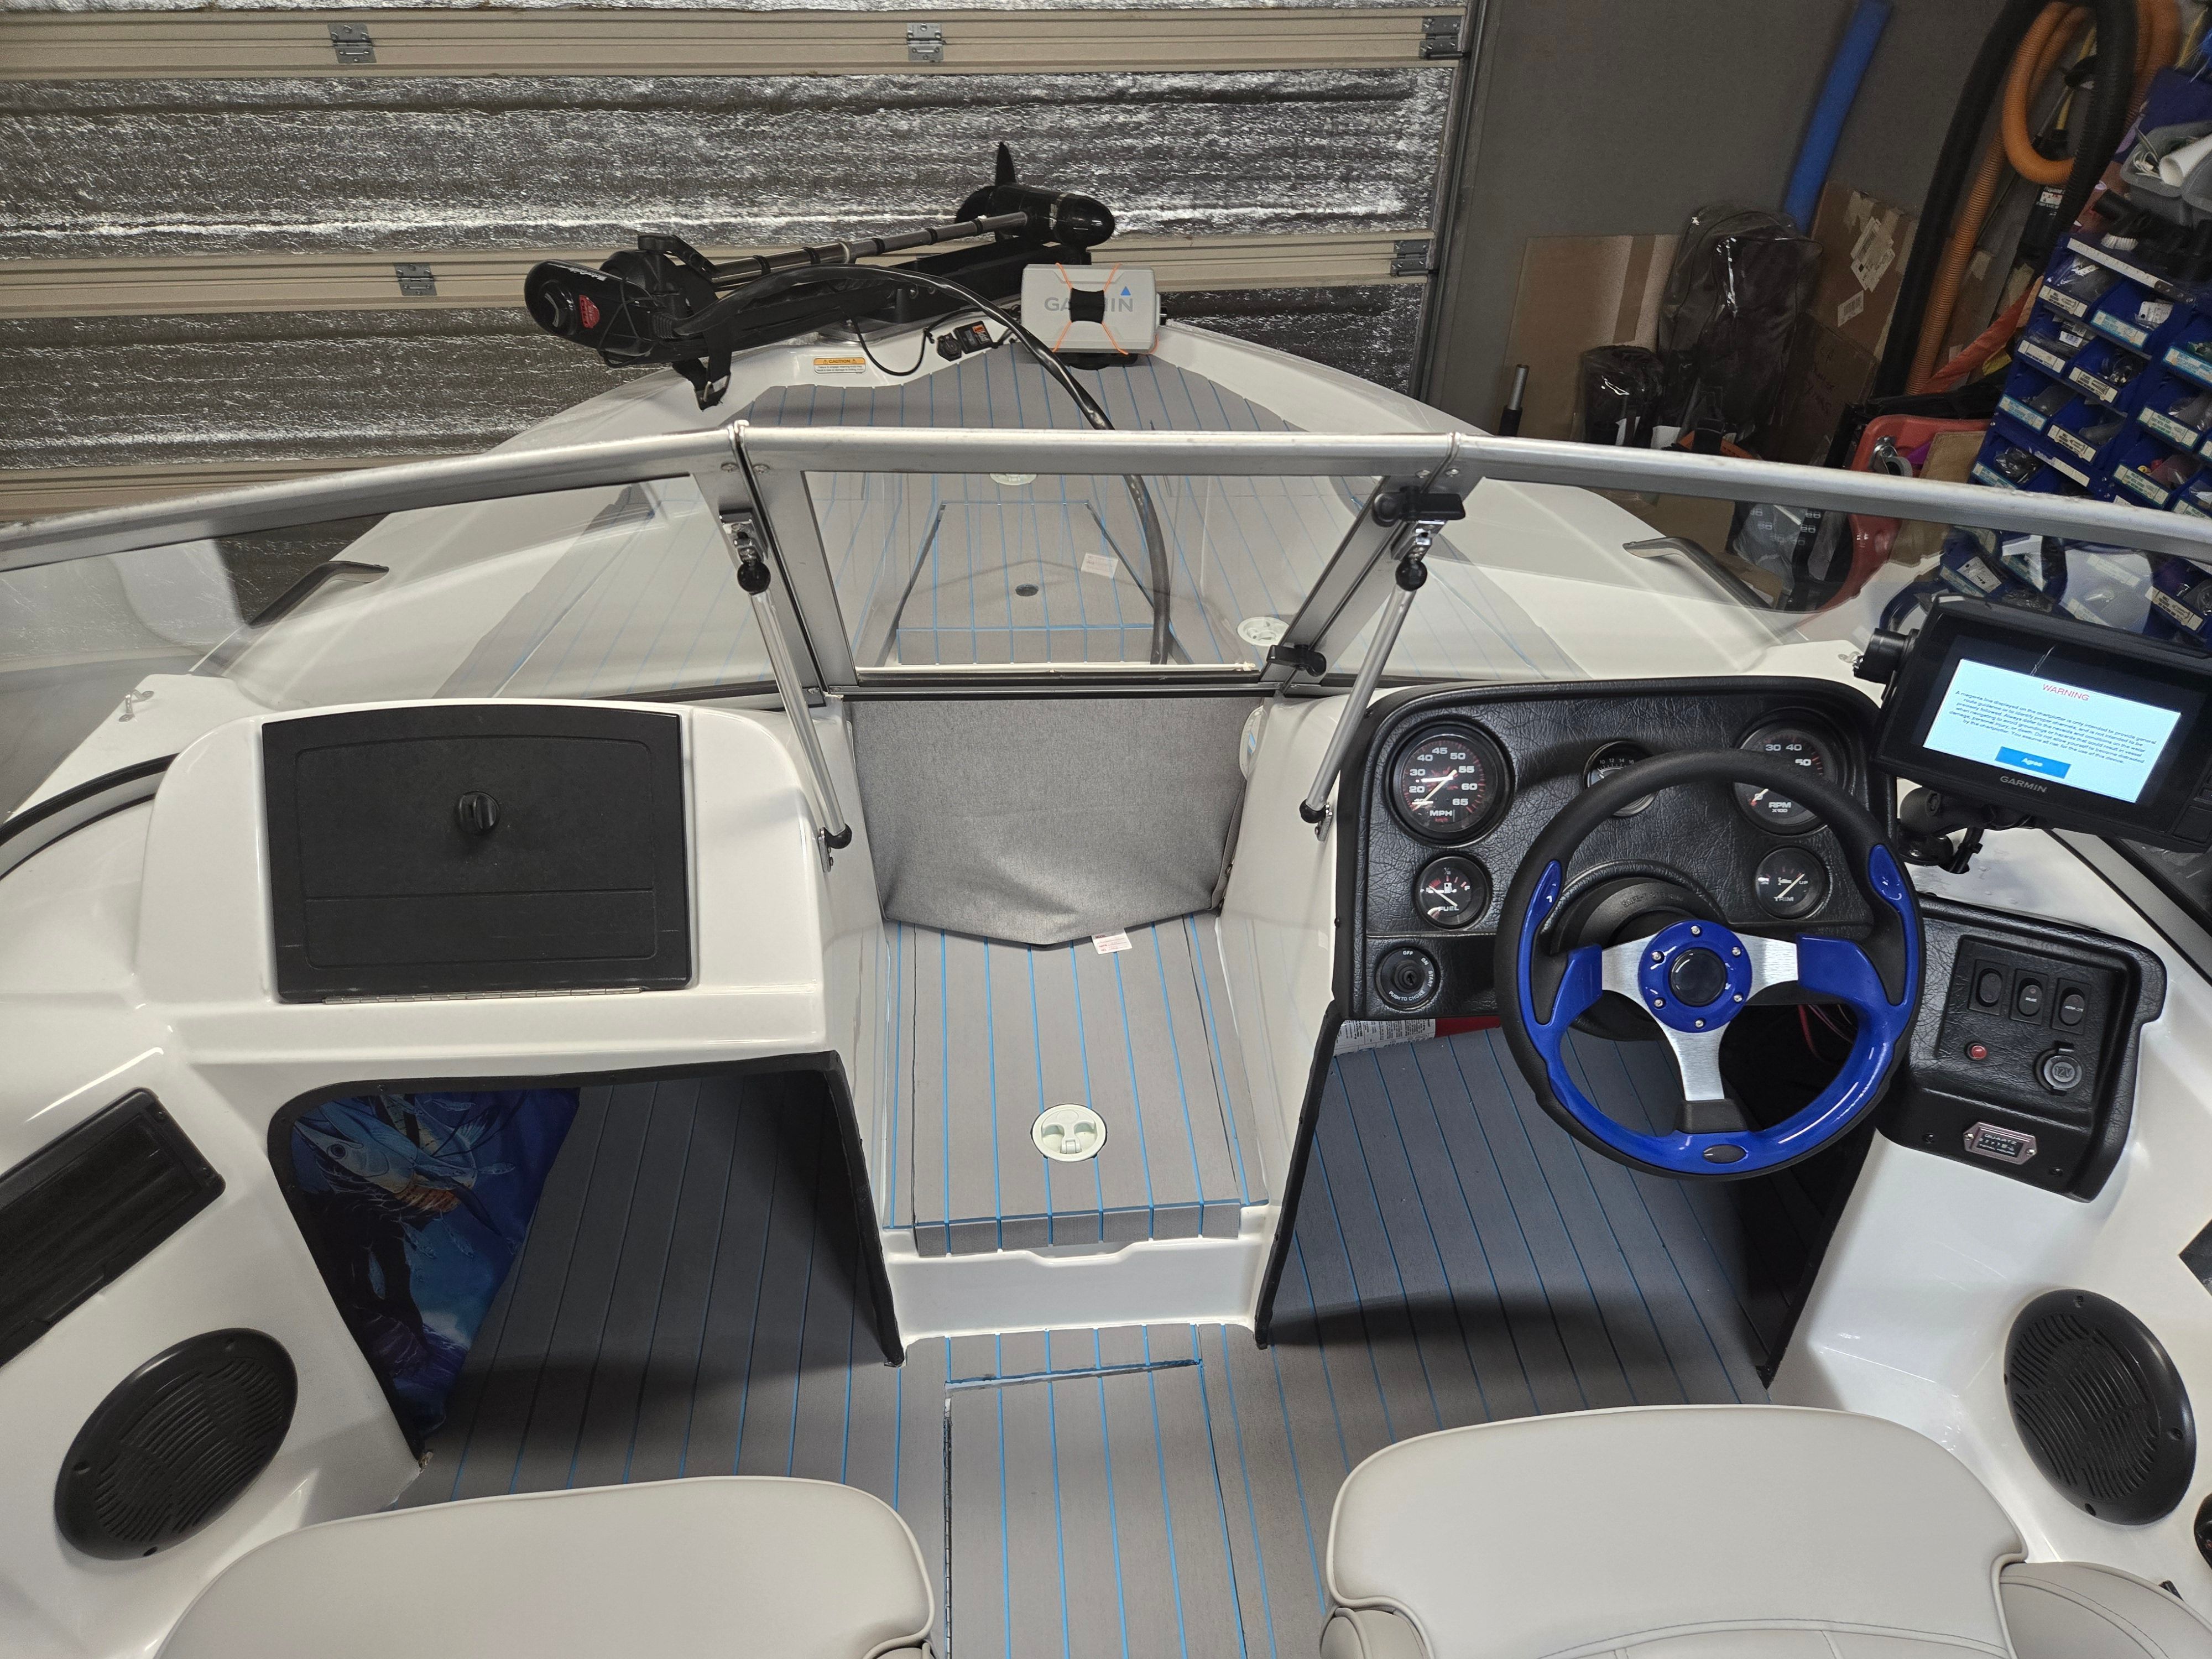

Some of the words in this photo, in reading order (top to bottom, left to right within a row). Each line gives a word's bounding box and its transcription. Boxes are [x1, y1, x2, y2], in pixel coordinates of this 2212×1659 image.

[1044, 297, 1133, 312] GAIN
[2043, 684, 2090, 701] WARNING
[2021, 758, 2043, 767] Agree
[2000, 776, 2048, 792] GARMIN
[1421, 957, 1429, 966] ON
[1389, 990, 1401, 1000] PUSH
[1408, 990, 1426, 1001] CHOKE
[2054, 1067, 2073, 1078] 12V
[1984, 1134, 2017, 1145] QUARTZ
